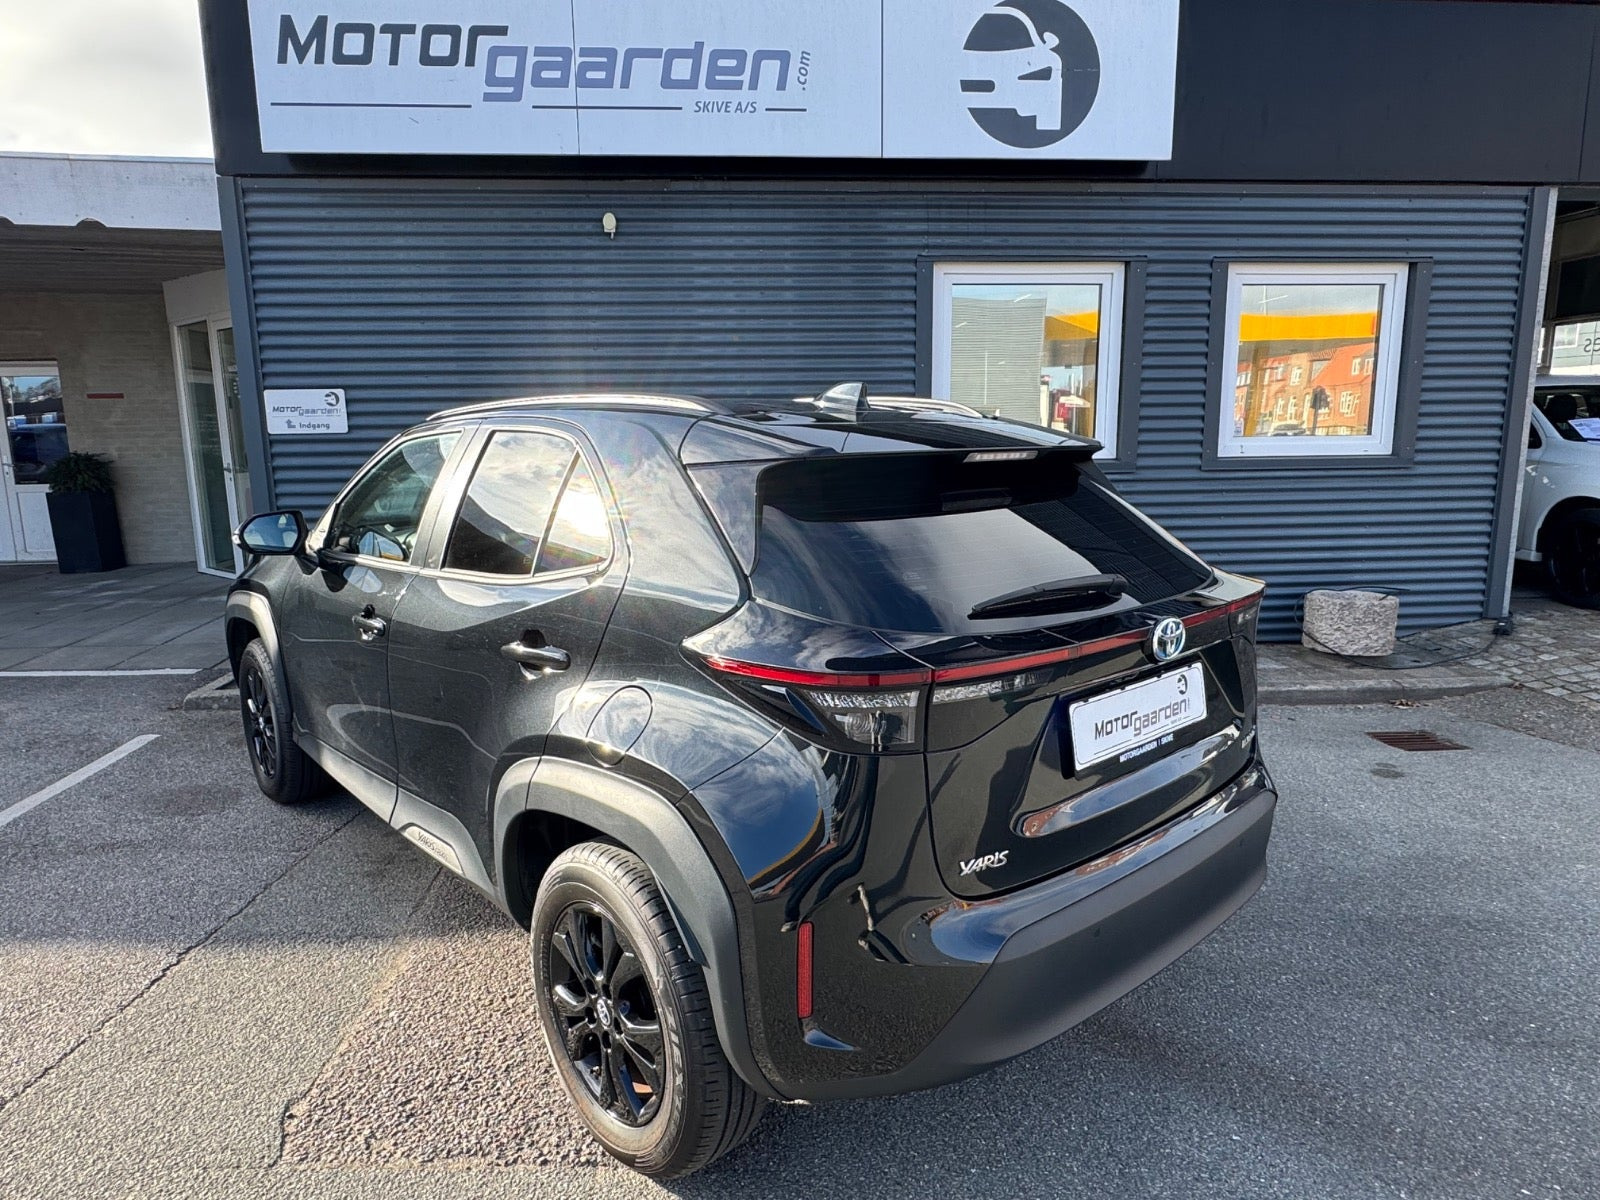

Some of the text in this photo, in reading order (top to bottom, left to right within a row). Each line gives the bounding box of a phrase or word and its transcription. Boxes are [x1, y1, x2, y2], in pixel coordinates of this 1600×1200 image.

[694, 100, 757, 114] SKIVE A/S
[299, 422, 331, 430] Indgang
[959, 850, 1009, 877] YARIS
